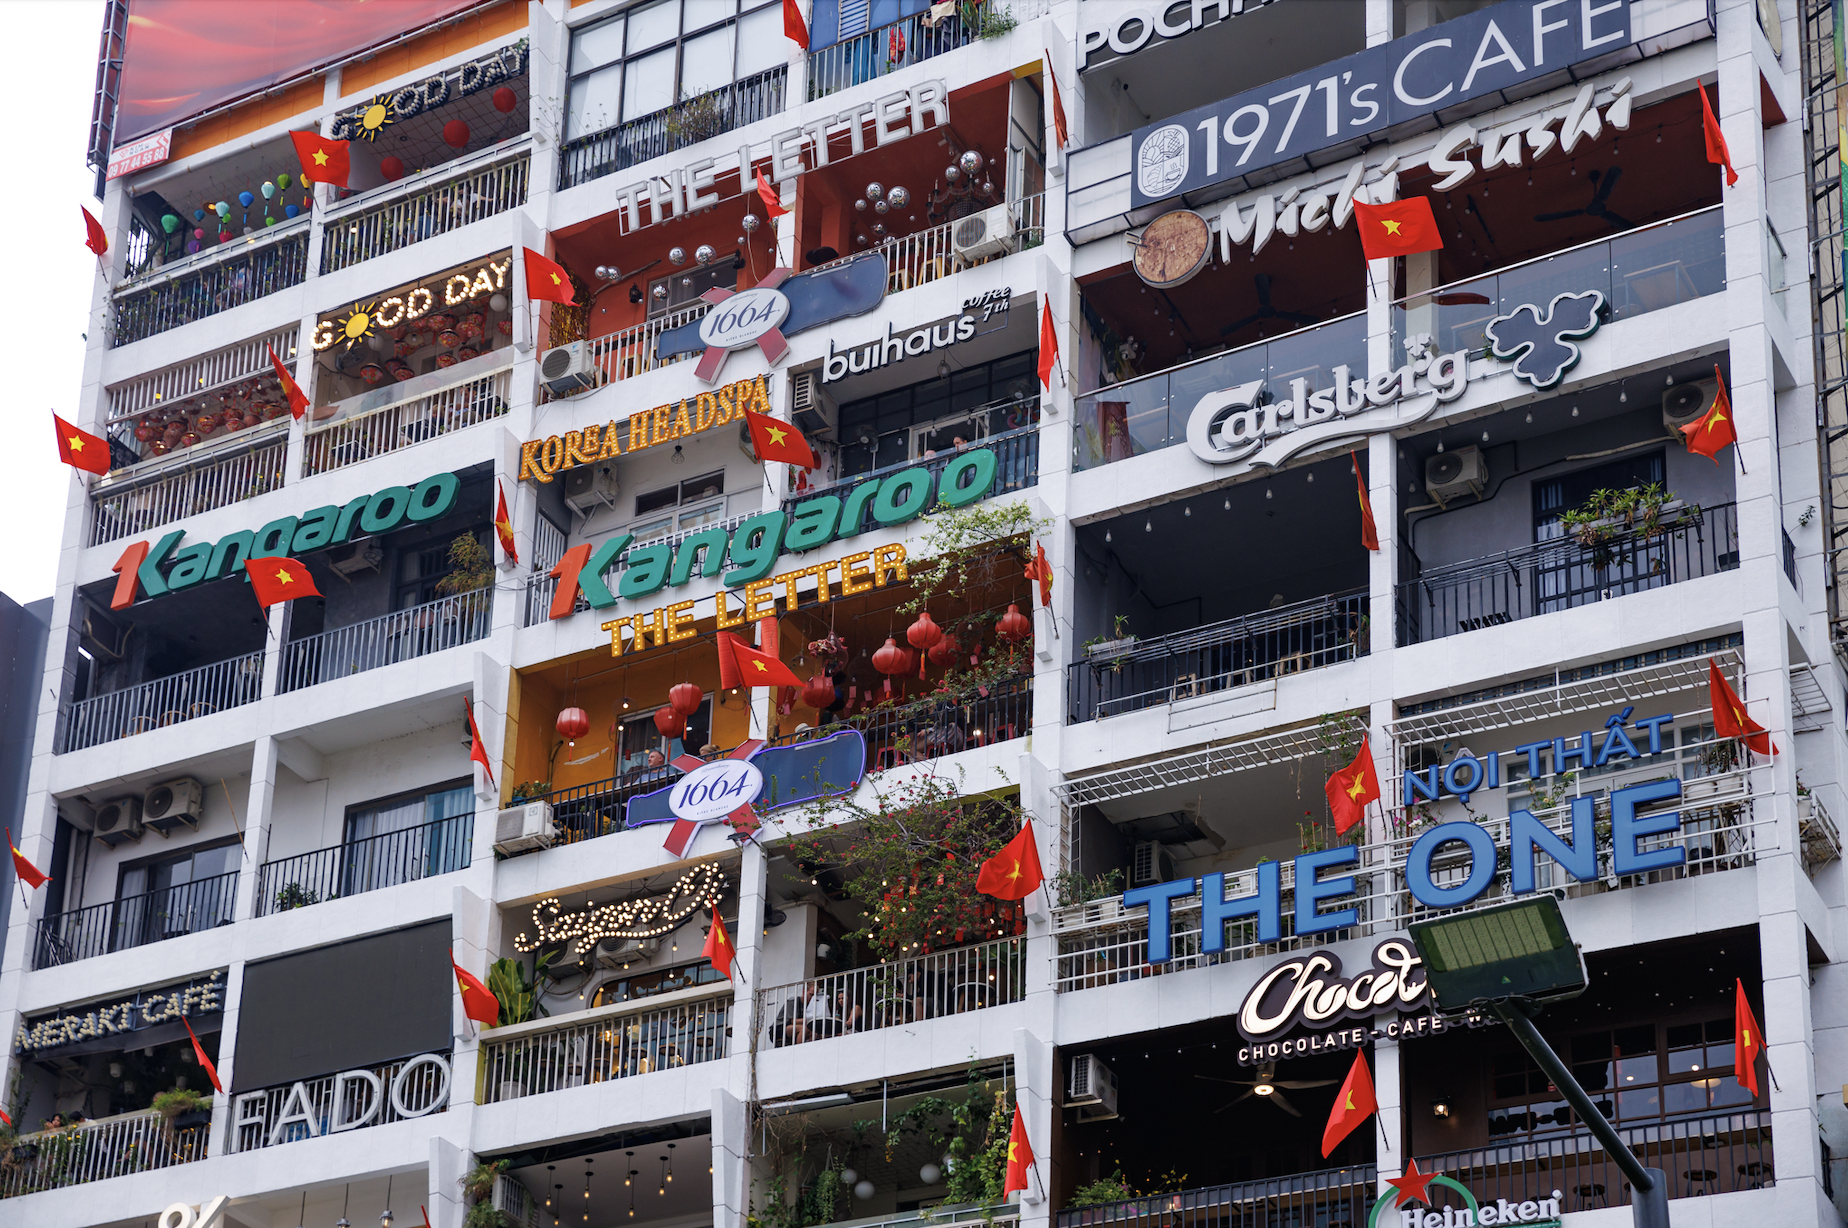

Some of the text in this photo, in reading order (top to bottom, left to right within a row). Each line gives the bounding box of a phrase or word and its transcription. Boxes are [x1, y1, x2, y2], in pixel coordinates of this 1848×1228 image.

[459, 38, 529, 95] DAY
[1197, 0, 1624, 177] 1971's CAFE
[108, 147, 165, 178] 09 77 44 55 88
[616, 78, 949, 232] THE LETTER
[1219, 76, 1632, 266] Michi Sushi
[445, 257, 512, 305] DAY
[961, 286, 1011, 309] coffee
[982, 298, 1010, 322] 7th
[708, 296, 778, 338] 1664
[822, 320, 976, 384] buihaus
[518, 373, 771, 484] KOREA HEADSPA
[1186, 348, 1470, 466] Carlsberg
[601, 543, 909, 657] THE LETTER
[1515, 706, 1673, 779] THẤT
[678, 769, 752, 809] 1664
[1123, 778, 1687, 964] THE ONE
[1238, 1028, 1363, 1062] CHOCOLATE
[1387, 1016, 1442, 1038] CAFE
[230, 1053, 451, 1154] FADO
[1400, 1196, 1562, 1228] Heineken
